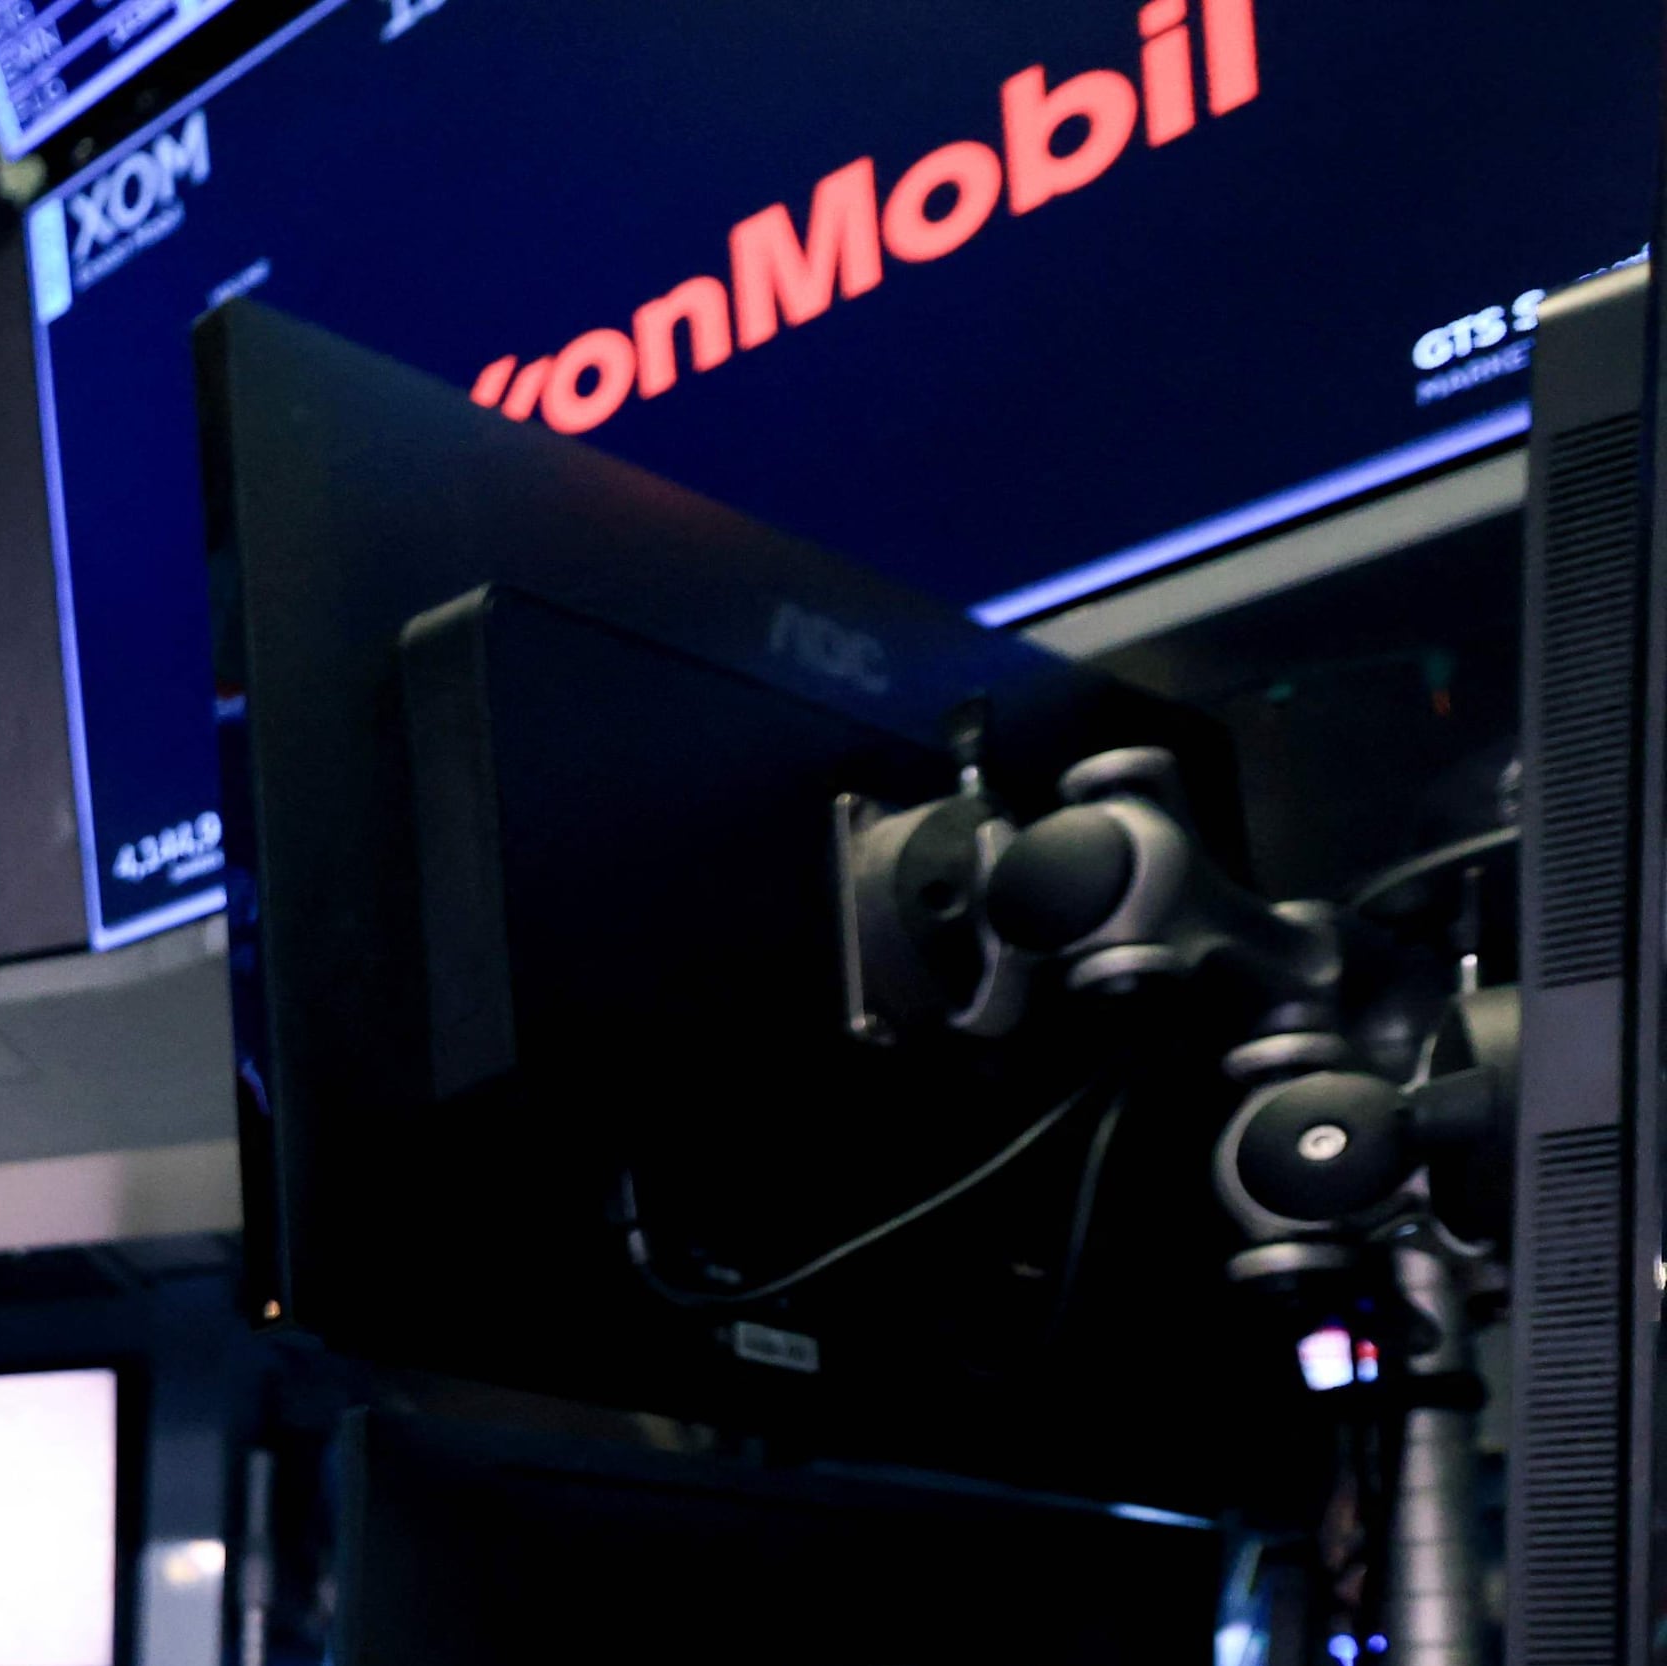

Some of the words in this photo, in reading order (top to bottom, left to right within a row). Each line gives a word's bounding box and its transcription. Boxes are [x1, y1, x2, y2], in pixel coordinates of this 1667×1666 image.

[69, 110, 210, 263] XOM
[469, 0, 1260, 436] onMobil
[1412, 305, 1508, 371] GTS
